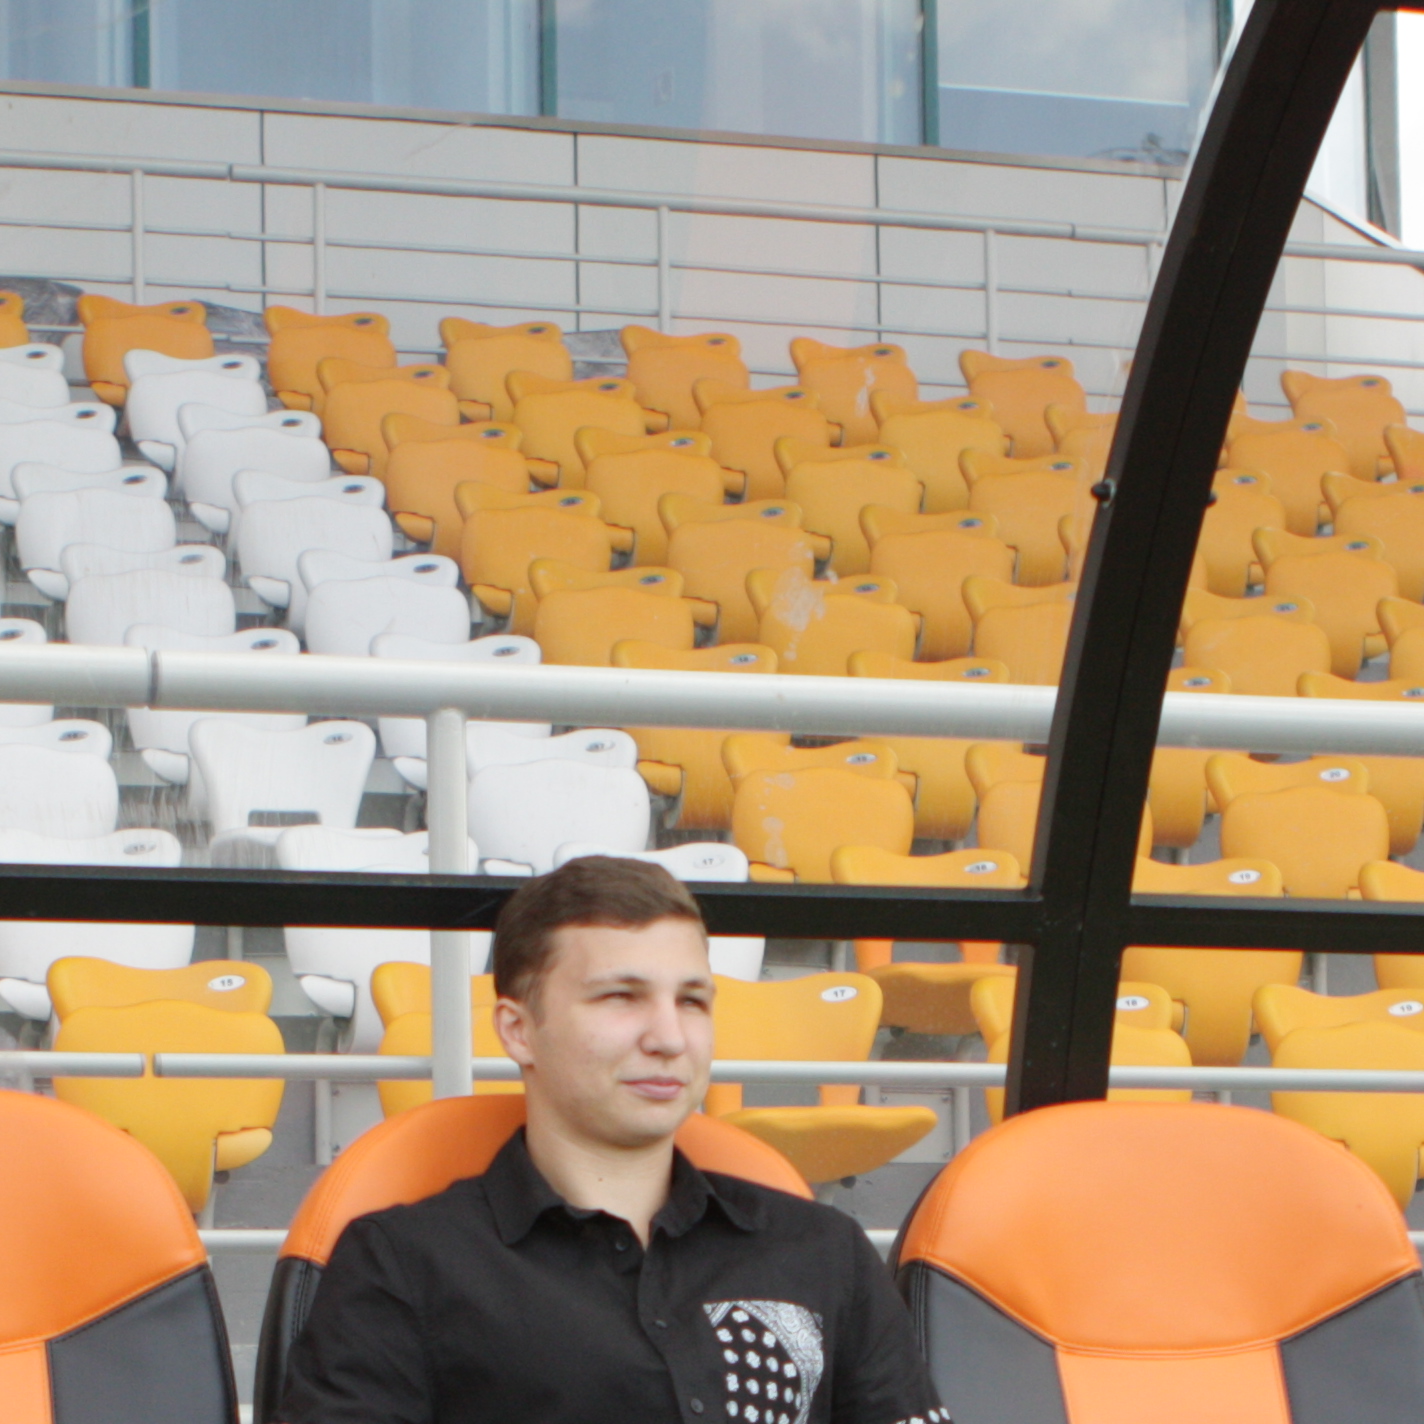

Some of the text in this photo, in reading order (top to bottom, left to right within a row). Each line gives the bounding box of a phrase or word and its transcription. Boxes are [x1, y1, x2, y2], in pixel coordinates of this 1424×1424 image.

[220, 979, 233, 987] 15
[833, 990, 844, 998] 17
[1400, 1004, 1412, 1012] 19
